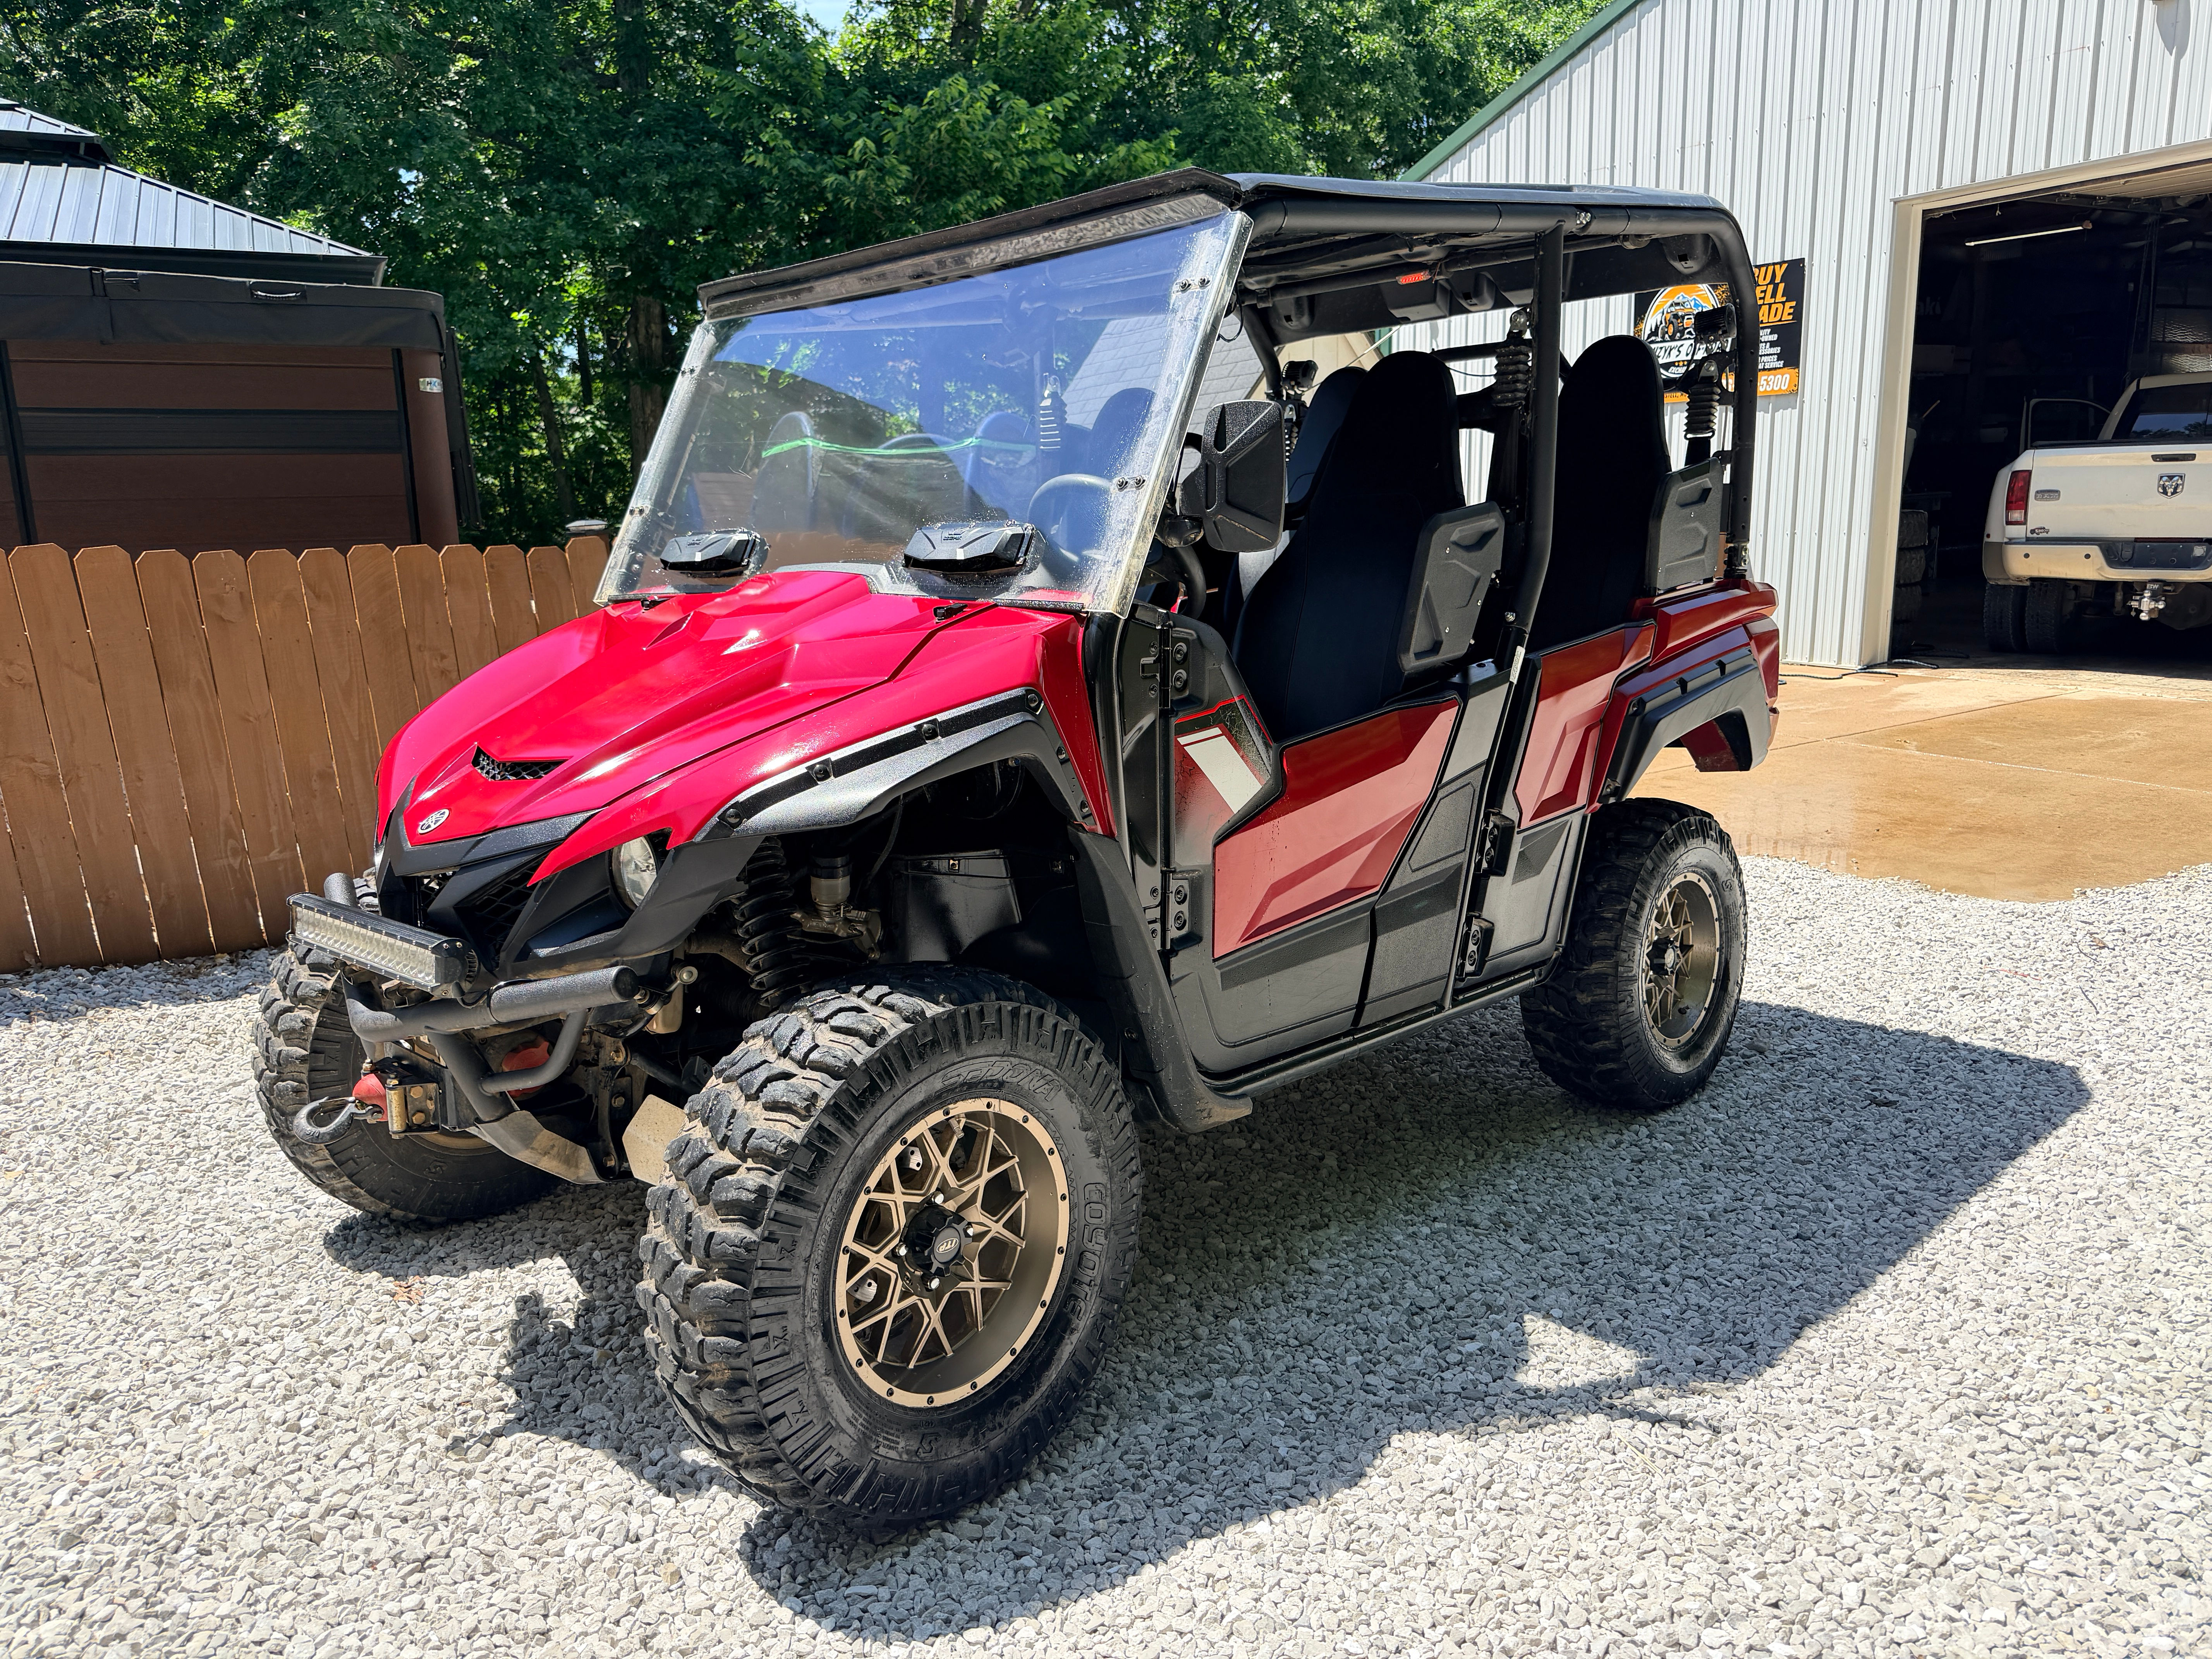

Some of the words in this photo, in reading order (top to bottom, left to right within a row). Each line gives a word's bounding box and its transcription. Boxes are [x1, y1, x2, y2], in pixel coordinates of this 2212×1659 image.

[1764, 361, 1784, 369] SERVICE
[933, 1060, 1061, 1102] SEDONA
[1063, 1182, 1106, 1321] COYOTE
